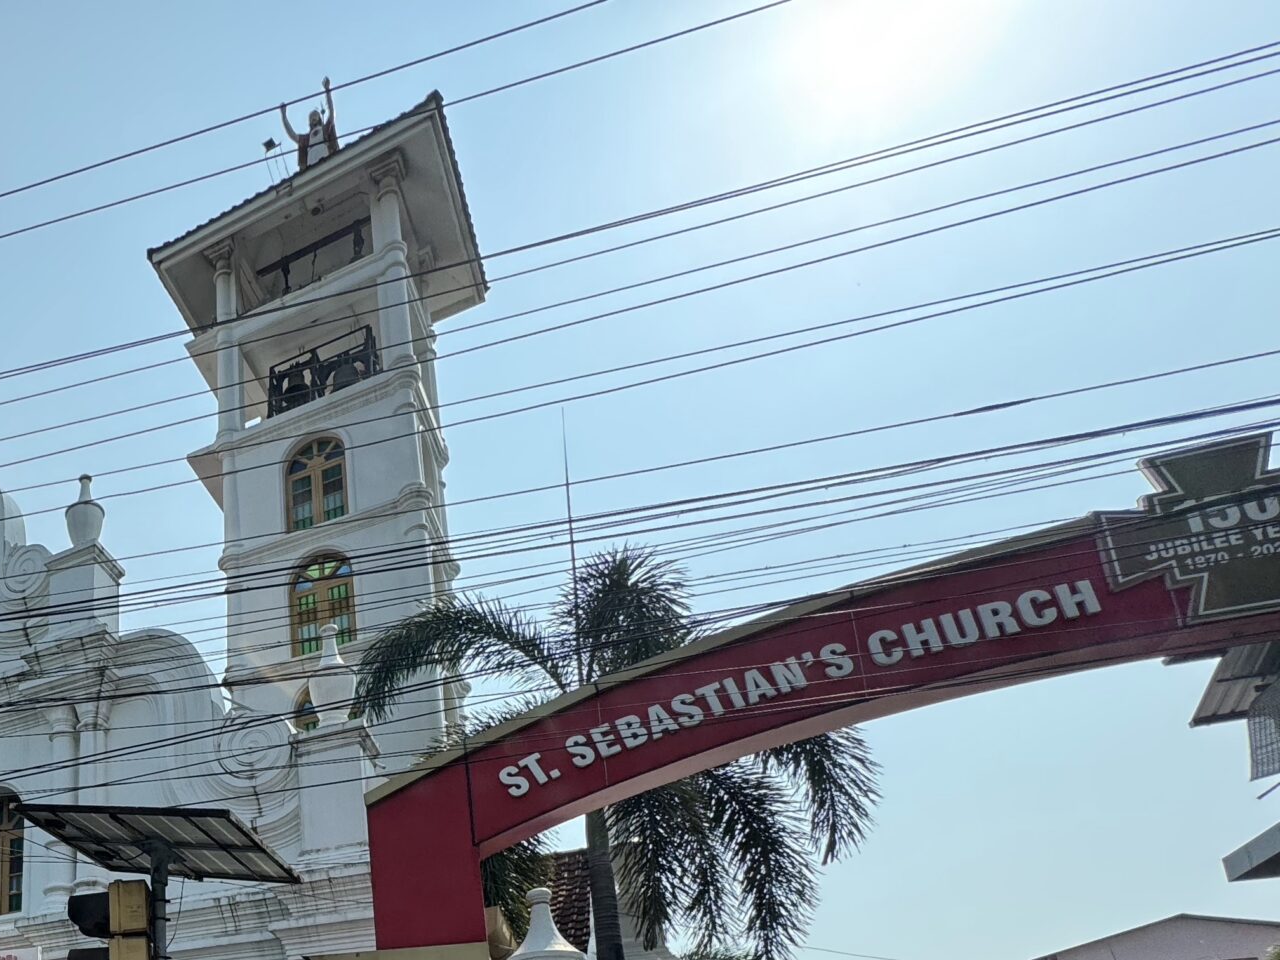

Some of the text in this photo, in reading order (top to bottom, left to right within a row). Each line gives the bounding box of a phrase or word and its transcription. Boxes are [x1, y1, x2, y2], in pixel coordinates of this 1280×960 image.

[1145, 529, 1244, 560] JUBILEE
[1184, 551, 1229, 569] 1870
[498, 579, 1102, 797] ST. SEBASTIAN'S CHURCH
